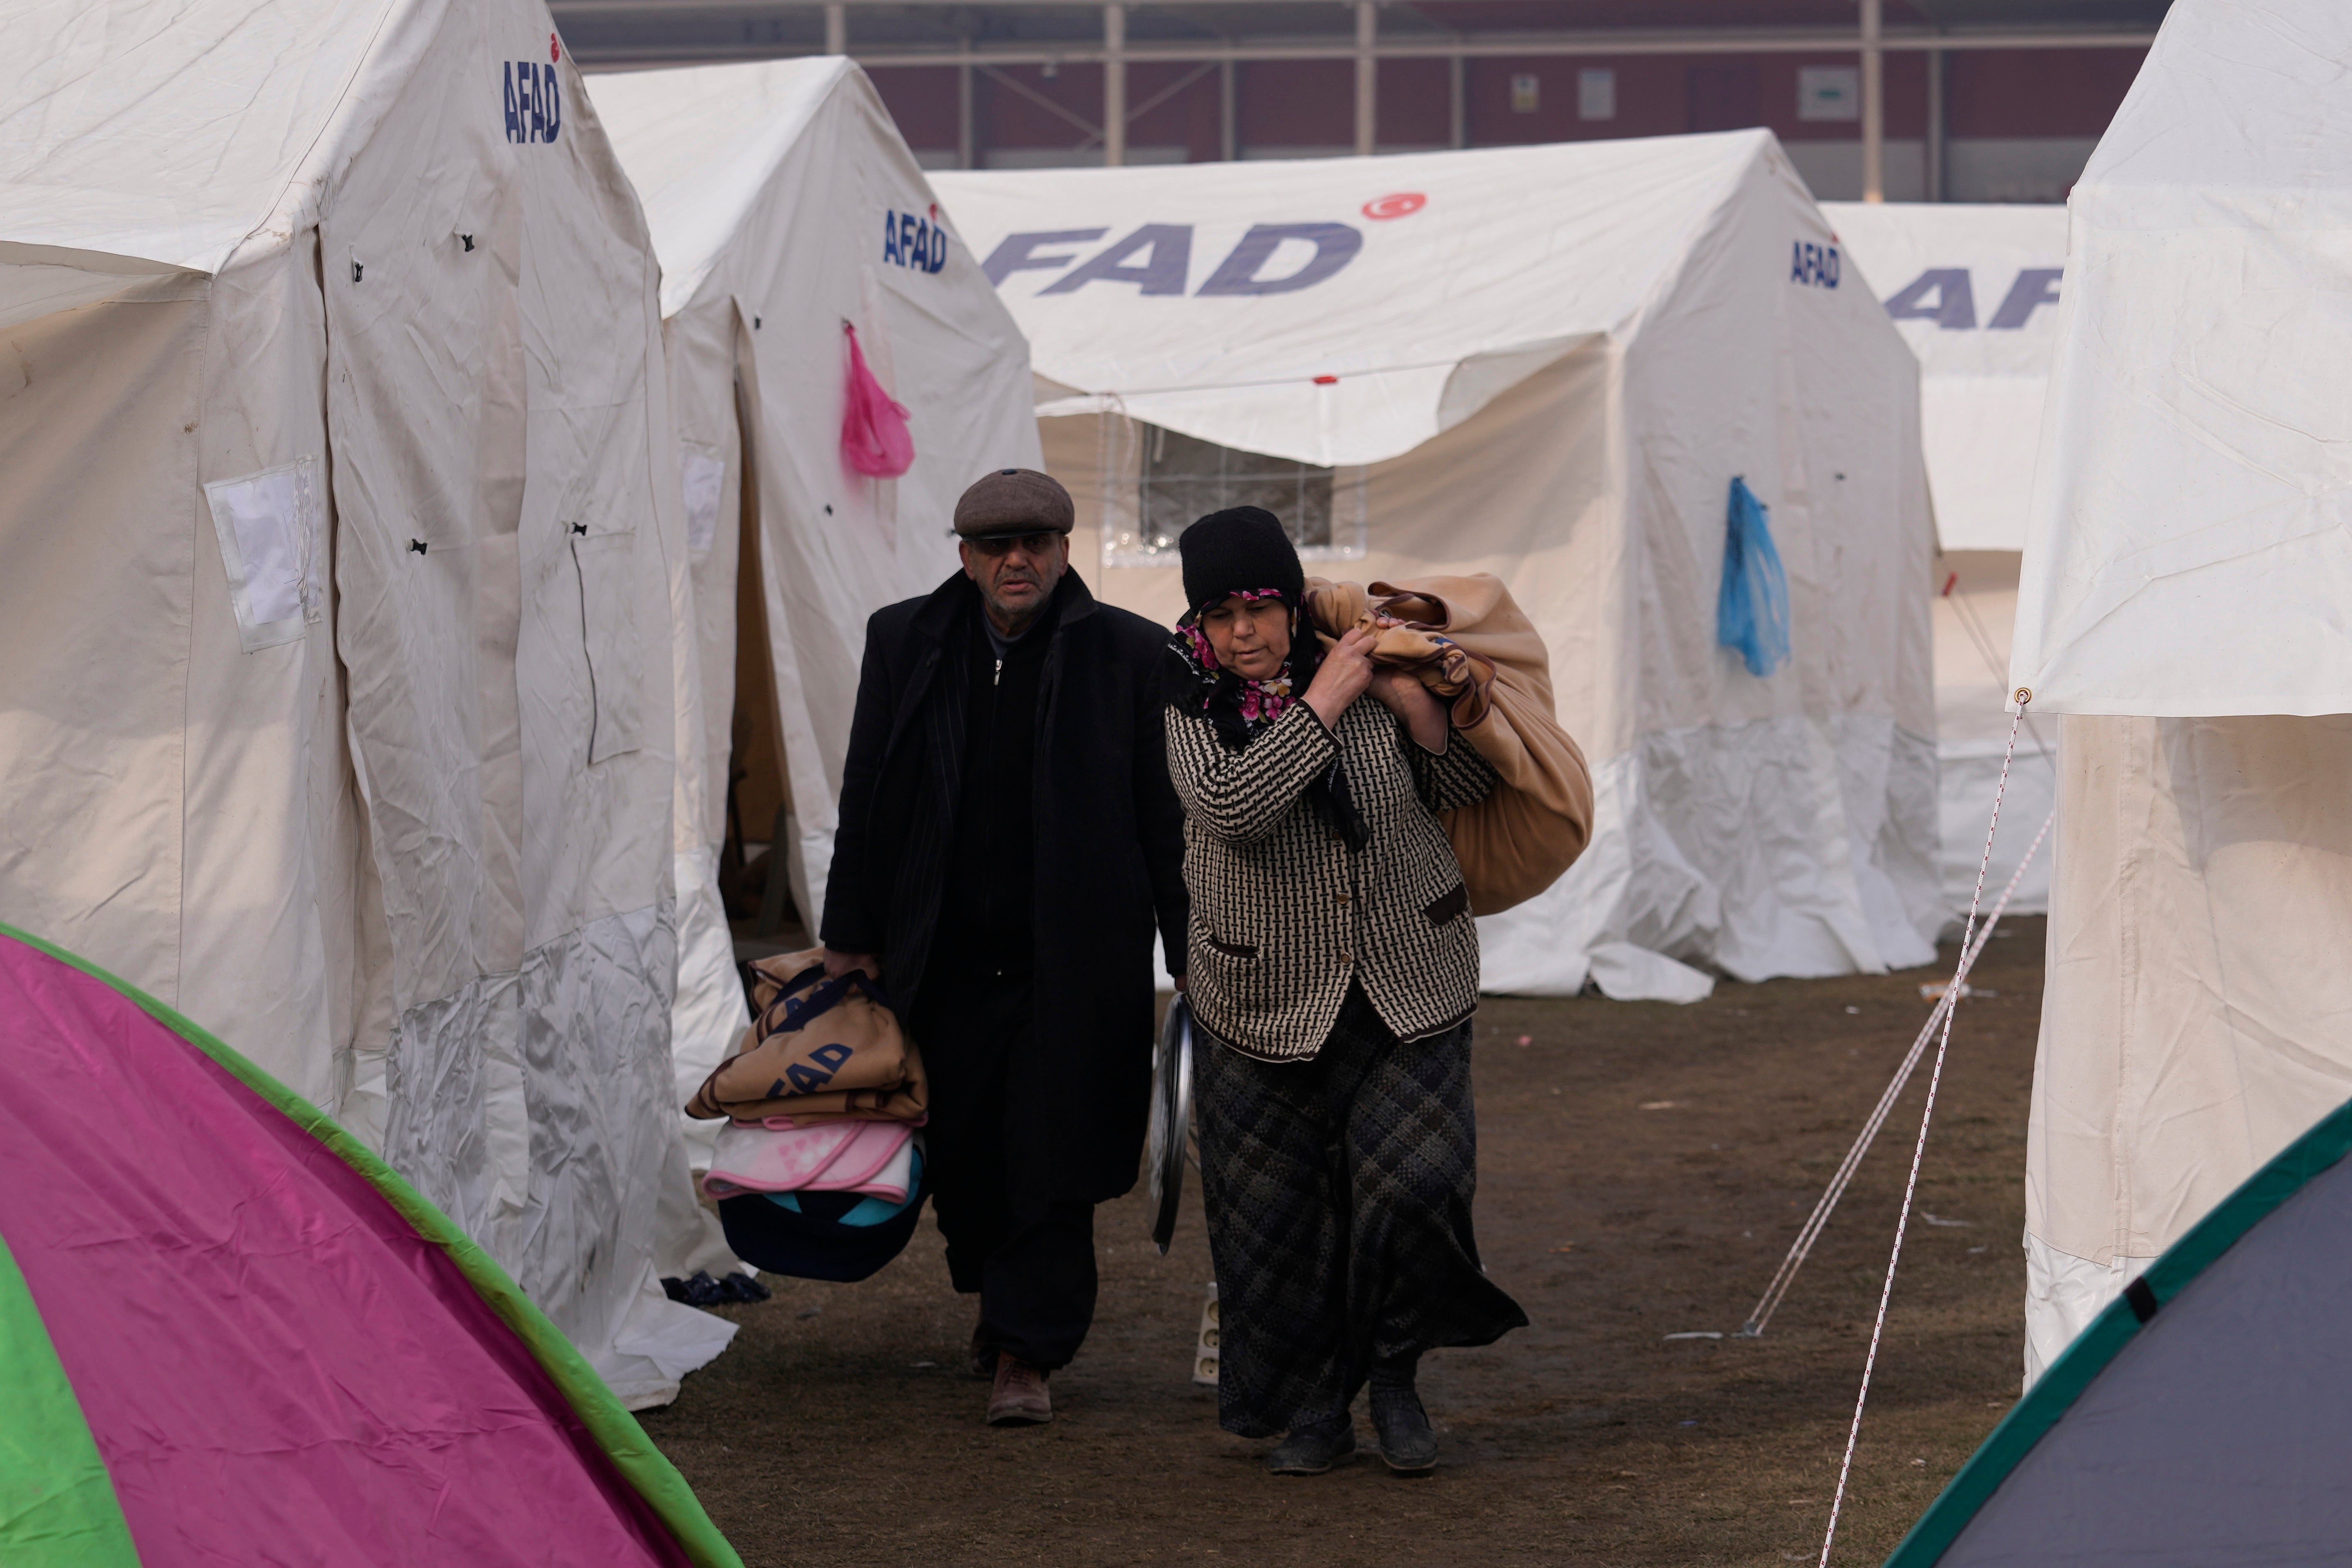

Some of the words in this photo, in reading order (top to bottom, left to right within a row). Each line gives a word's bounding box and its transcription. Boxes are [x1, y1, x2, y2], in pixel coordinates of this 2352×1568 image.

[504, 61, 560, 143] AFAD
[884, 209, 946, 274] AFAD
[1791, 240, 1839, 289] AFAD
